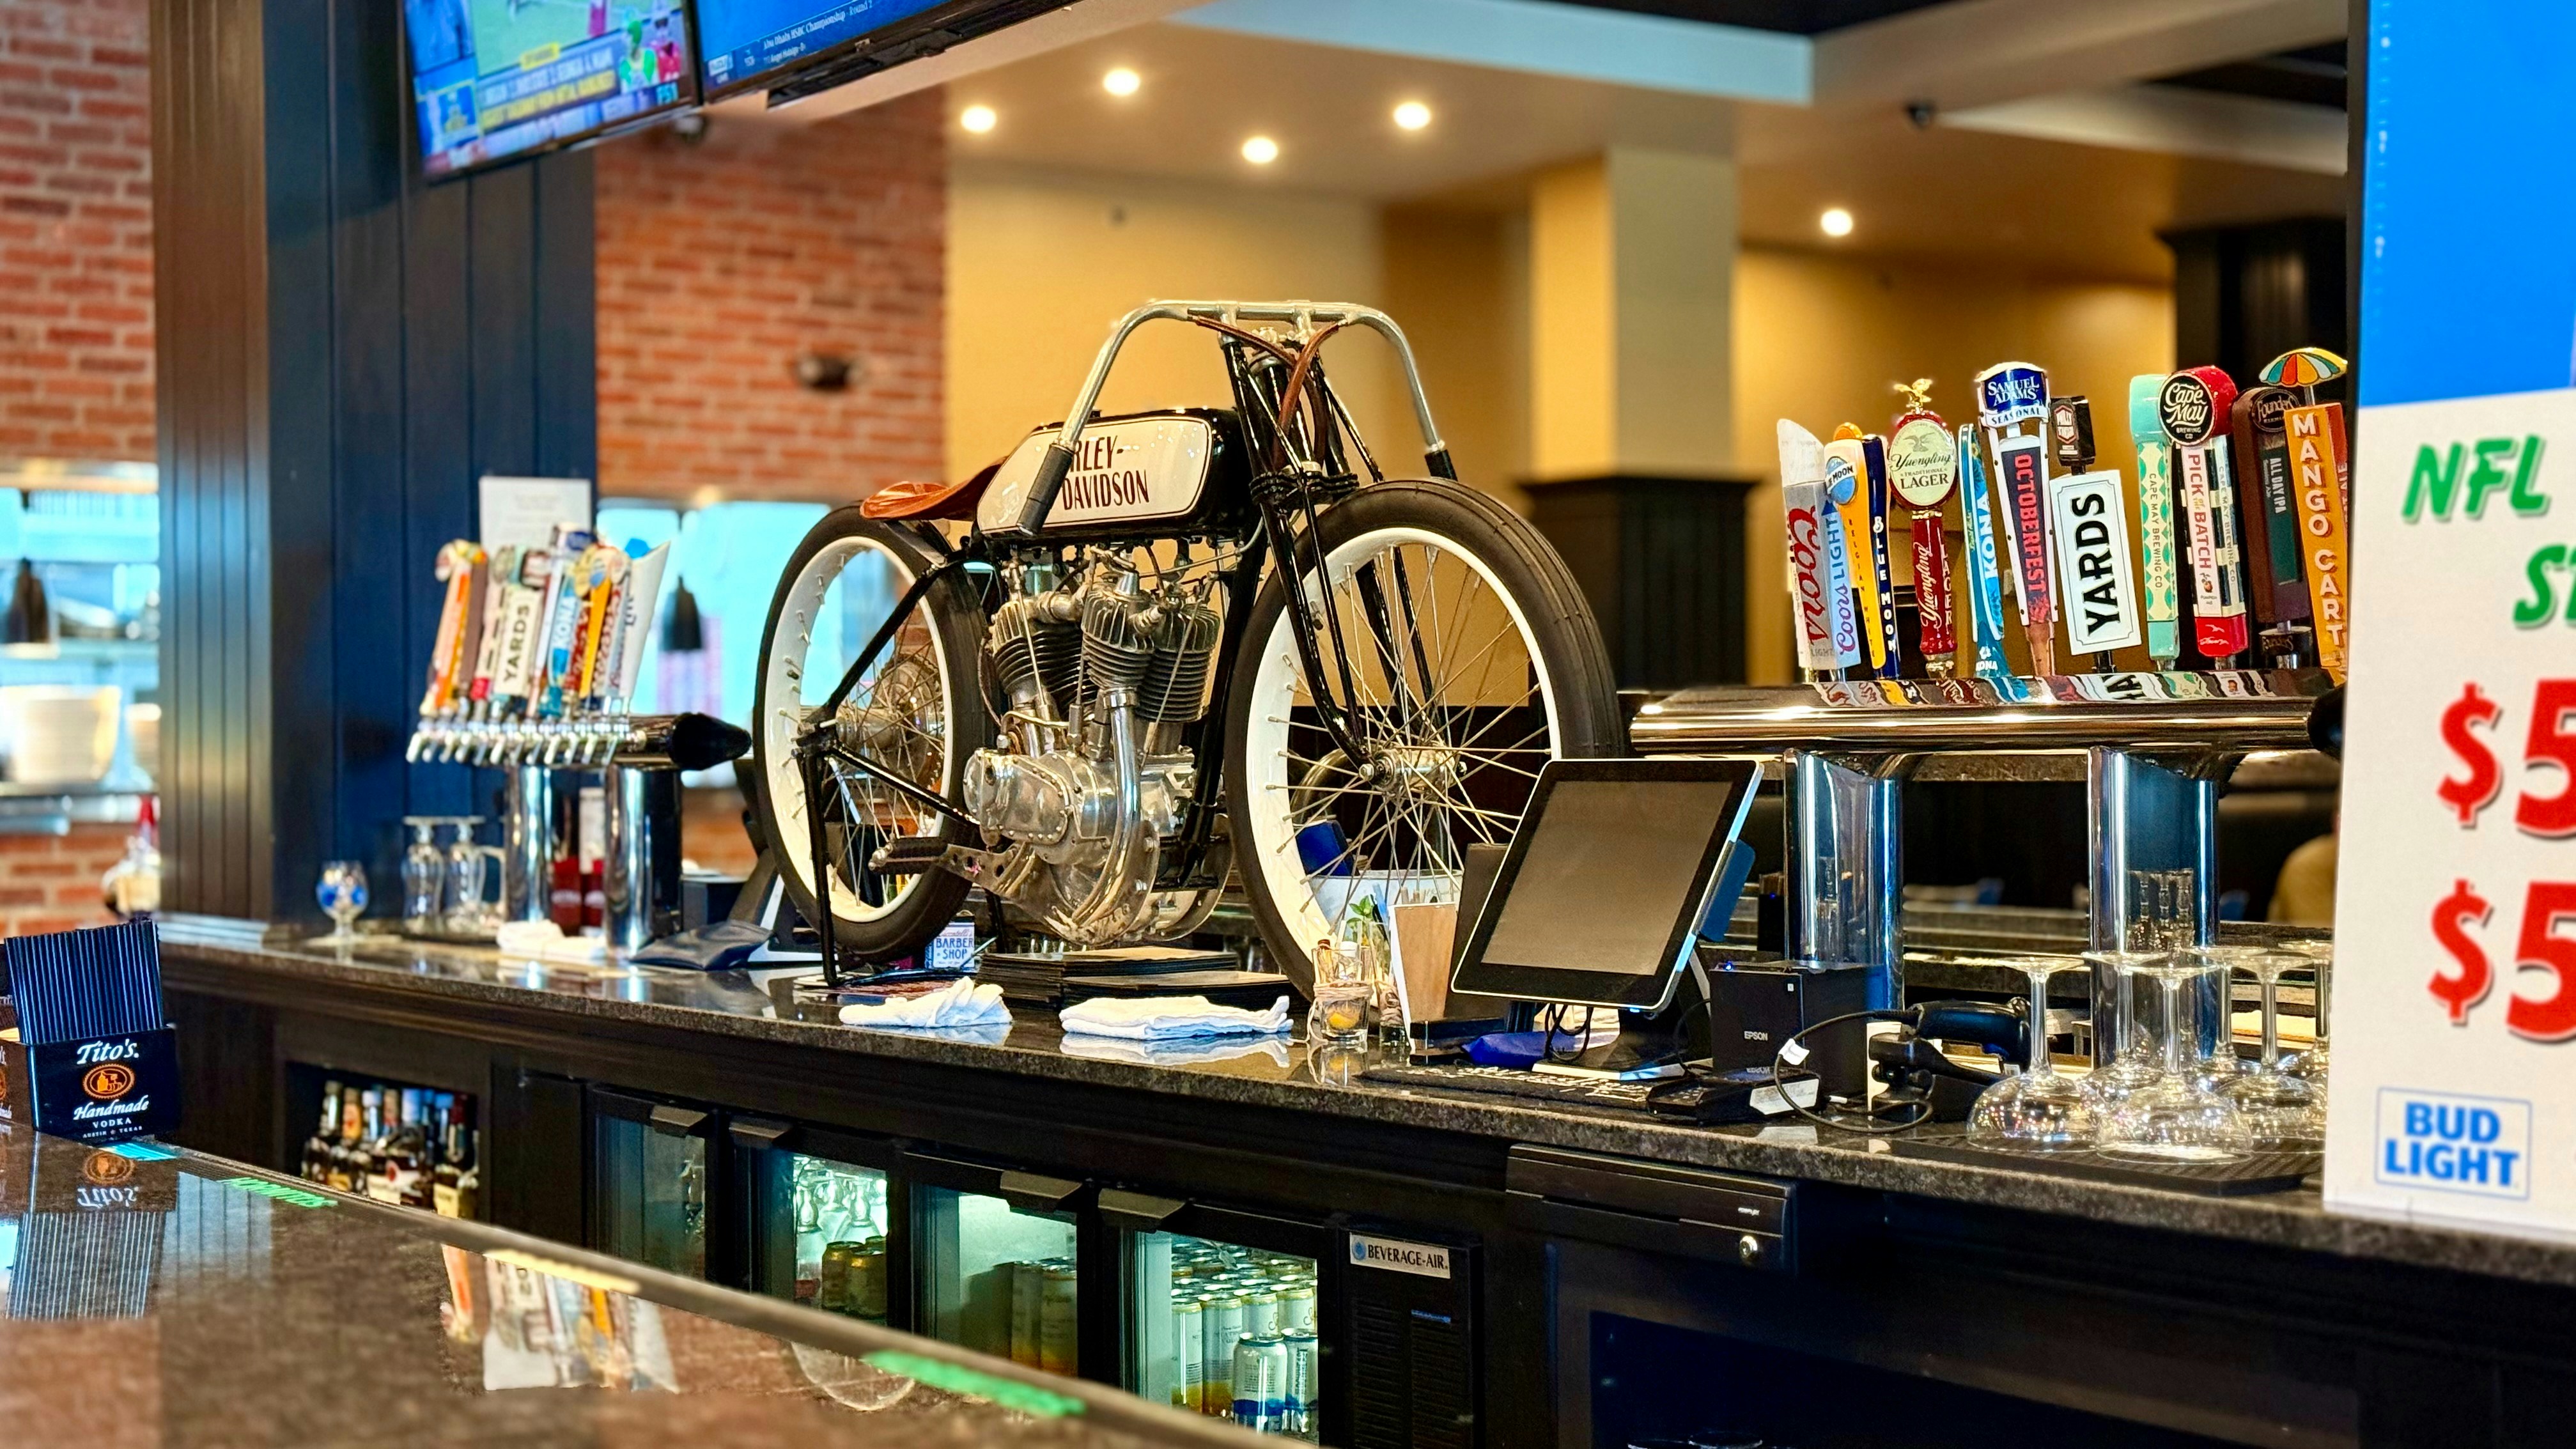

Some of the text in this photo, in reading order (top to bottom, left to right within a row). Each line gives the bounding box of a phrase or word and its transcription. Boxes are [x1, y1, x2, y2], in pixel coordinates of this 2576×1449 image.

[791, 25, 805, 41] HSBC
[805, 11, 846, 34] Championship
[850, 3, 868, 17] Round
[1988, 376, 2039, 396] SAMUEL
[1993, 388, 2037, 407] ADAMS
[2165, 383, 2207, 408] Cape
[1991, 407, 2041, 425] SEASONAL
[2164, 403, 2208, 428] May
[1070, 435, 1124, 473] RLEY-
[1832, 465, 1854, 481] MOON
[1889, 452, 1951, 471] Yuengling
[1905, 468, 1943, 477] TRADITIONAL
[1062, 469, 1149, 510] DAVIDSON
[1900, 473, 1949, 490] LAGER
[2149, 473, 2159, 500] CAPE
[2188, 454, 2205, 497] PICK
[2219, 466, 2227, 494] CAPE
[2269, 457, 2287, 514] ALL DAY IPA
[2401, 433, 2548, 520] NFL
[2014, 453, 2047, 593] OCTOBERFEST
[2151, 503, 2159, 525] MAY
[2221, 496, 2230, 517] MAY
[1977, 490, 1999, 579] KONA
[2194, 511, 2212, 569] BATCH
[2225, 521, 2235, 566] BREWING
[2292, 411, 2331, 536] MANGO
[2314, 548, 2345, 647] CART
[2070, 493, 2121, 637] YARDS
[2152, 528, 2162, 572] BREWING
[1788, 505, 1829, 646] Coors
[1826, 516, 1856, 655] Coors LIGHT
[1873, 516, 1897, 652] BLUE MOON
[1913, 542, 1943, 629] Yuengling
[1941, 543, 1952, 626] LAGER
[503, 604, 531, 682] YARDS
[936, 938, 974, 949] BARBER
[943, 949, 967, 959] SHOP
[1744, 1030, 1769, 1041] EPSON
[73, 1095, 150, 1120] Handmade
[93, 1117, 132, 1129] VODKA
[2404, 1101, 2502, 1144] BUD
[2384, 1139, 2520, 1188] LIGHT
[1368, 1244, 1446, 1269] BEVERAGE-AIR
